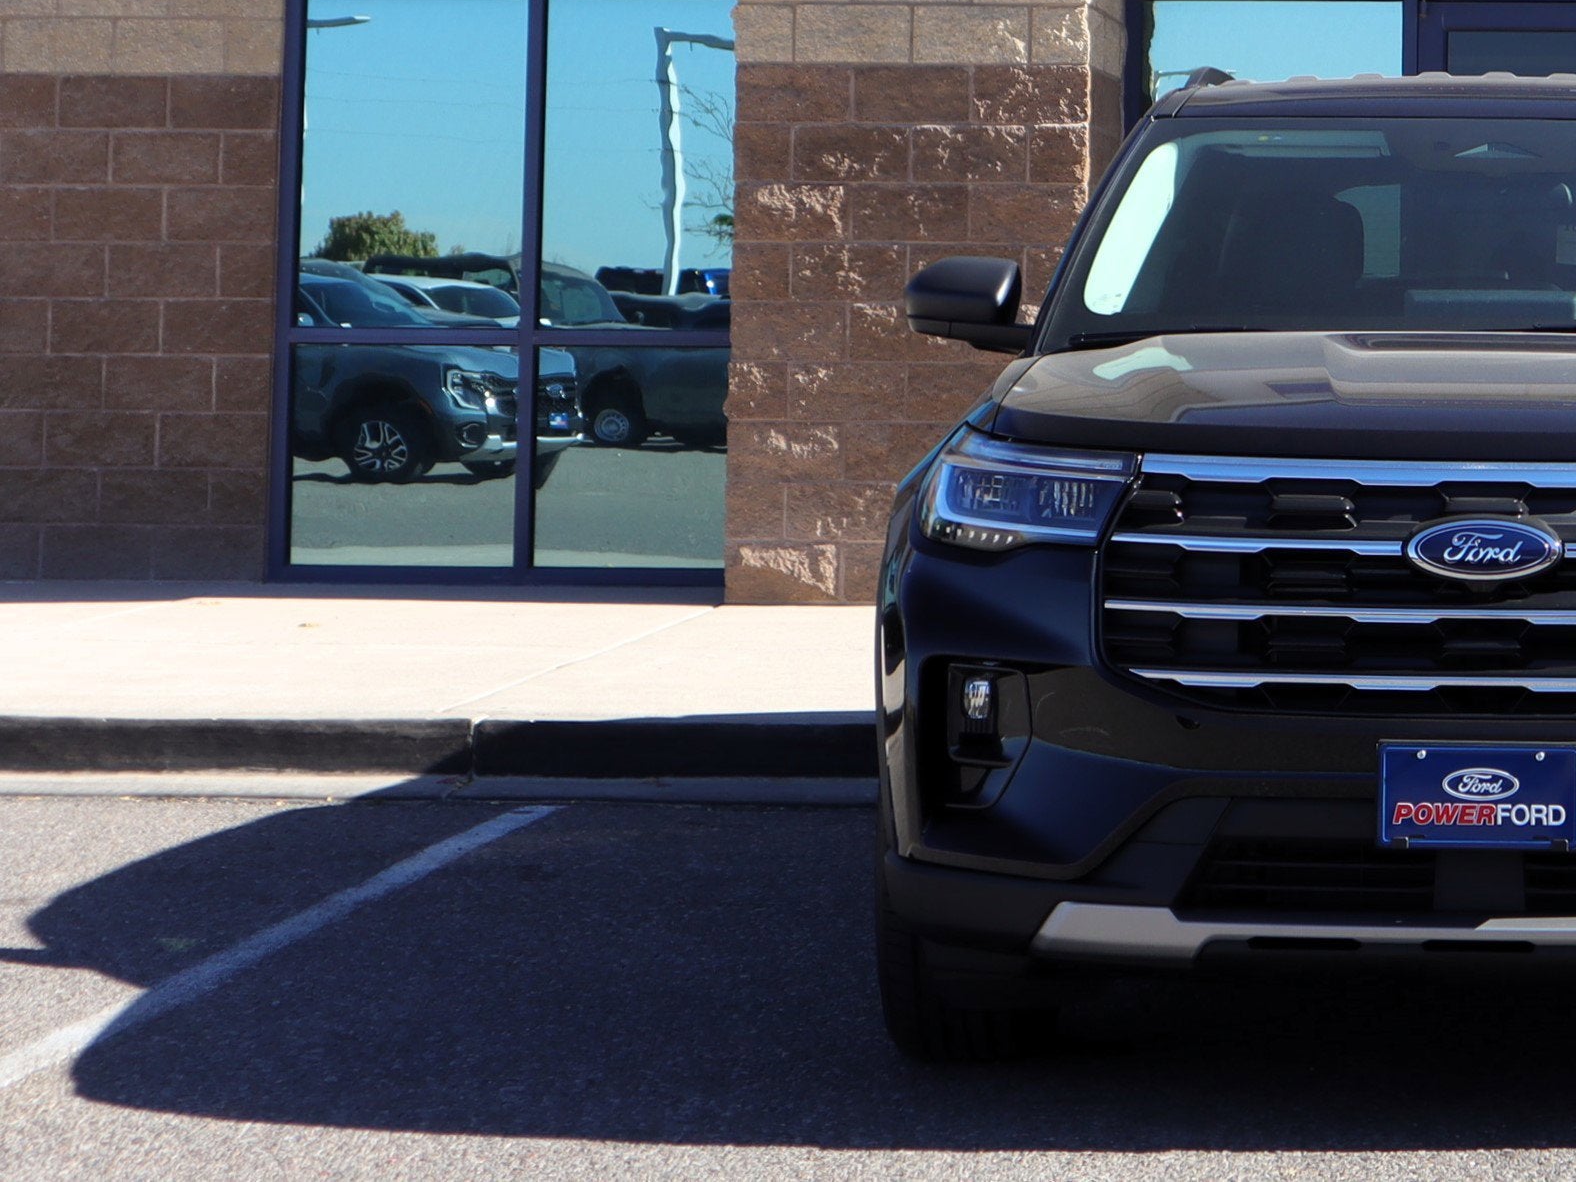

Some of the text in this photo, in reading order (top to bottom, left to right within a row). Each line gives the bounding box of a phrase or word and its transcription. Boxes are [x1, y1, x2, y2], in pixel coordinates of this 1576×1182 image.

[1444, 531, 1524, 564] Ford
[1458, 774, 1503, 795] Ford
[1393, 802, 1566, 827] POWERFORD
